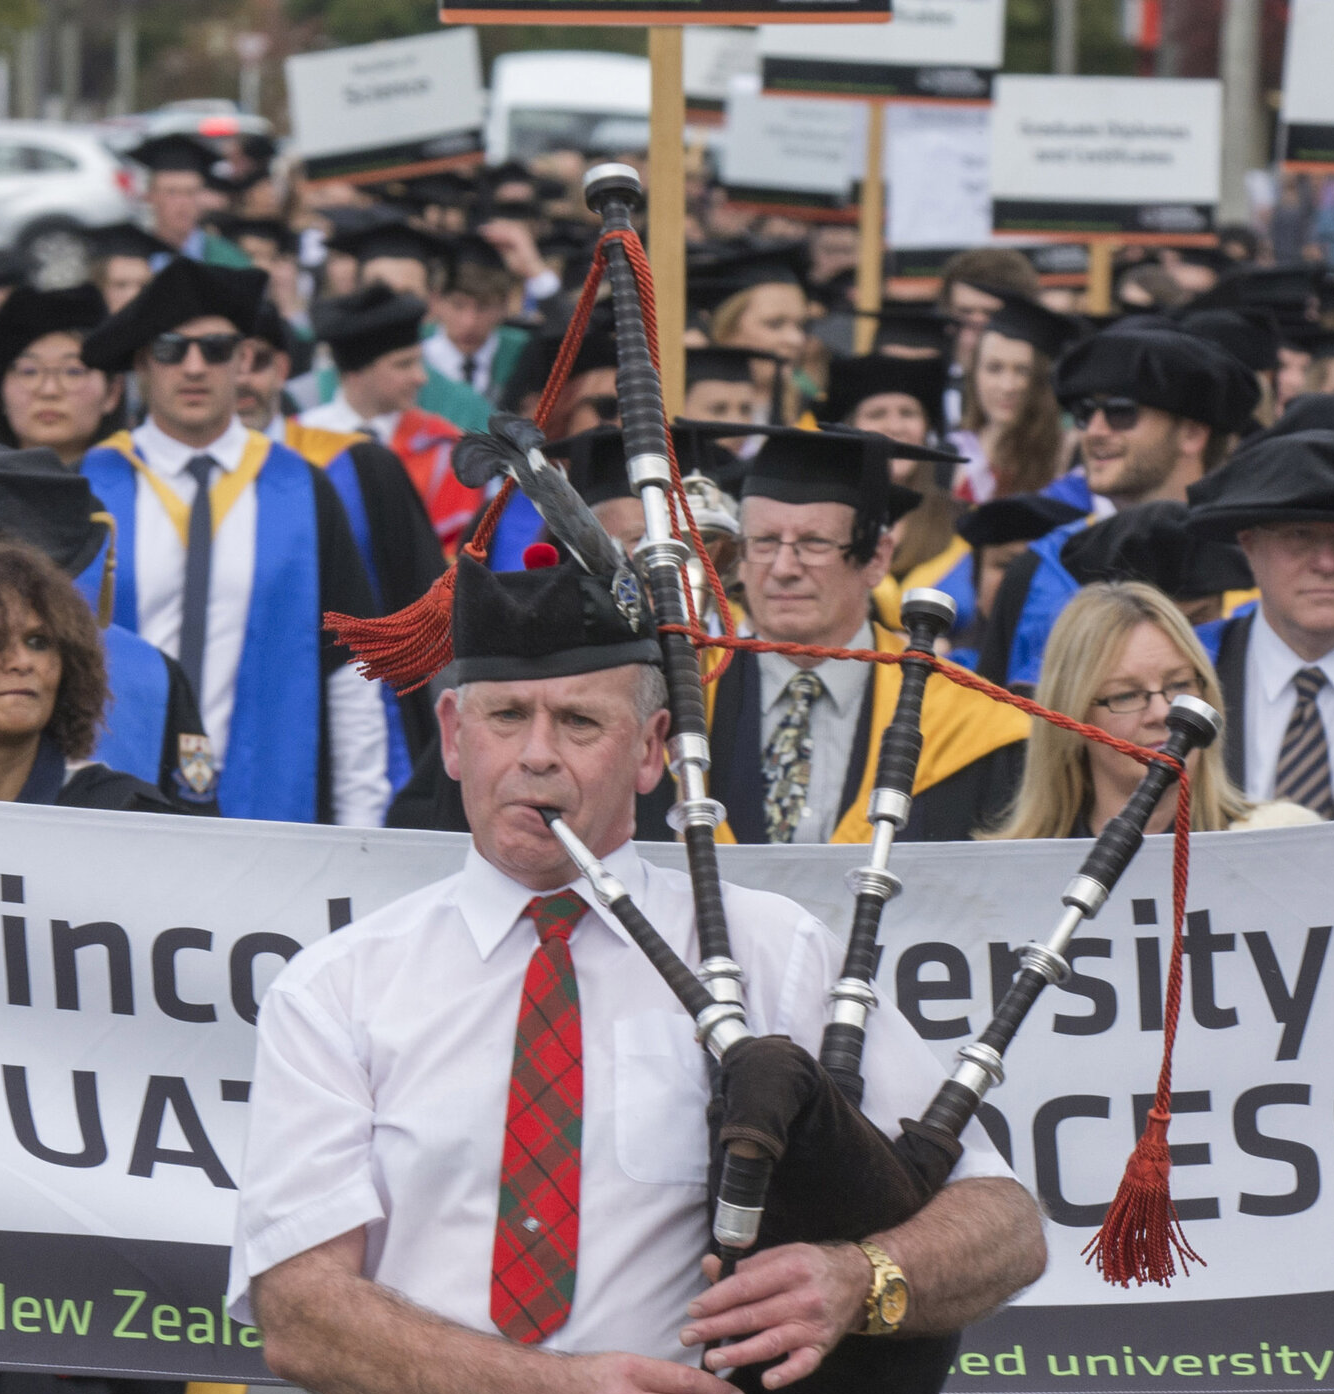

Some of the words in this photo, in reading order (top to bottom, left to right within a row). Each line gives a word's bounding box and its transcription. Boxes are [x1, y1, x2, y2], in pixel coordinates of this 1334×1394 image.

[872, 898, 1333, 1062] ersity
[948, 1345, 1027, 1376] ed
[1048, 1342, 1334, 1381] university
